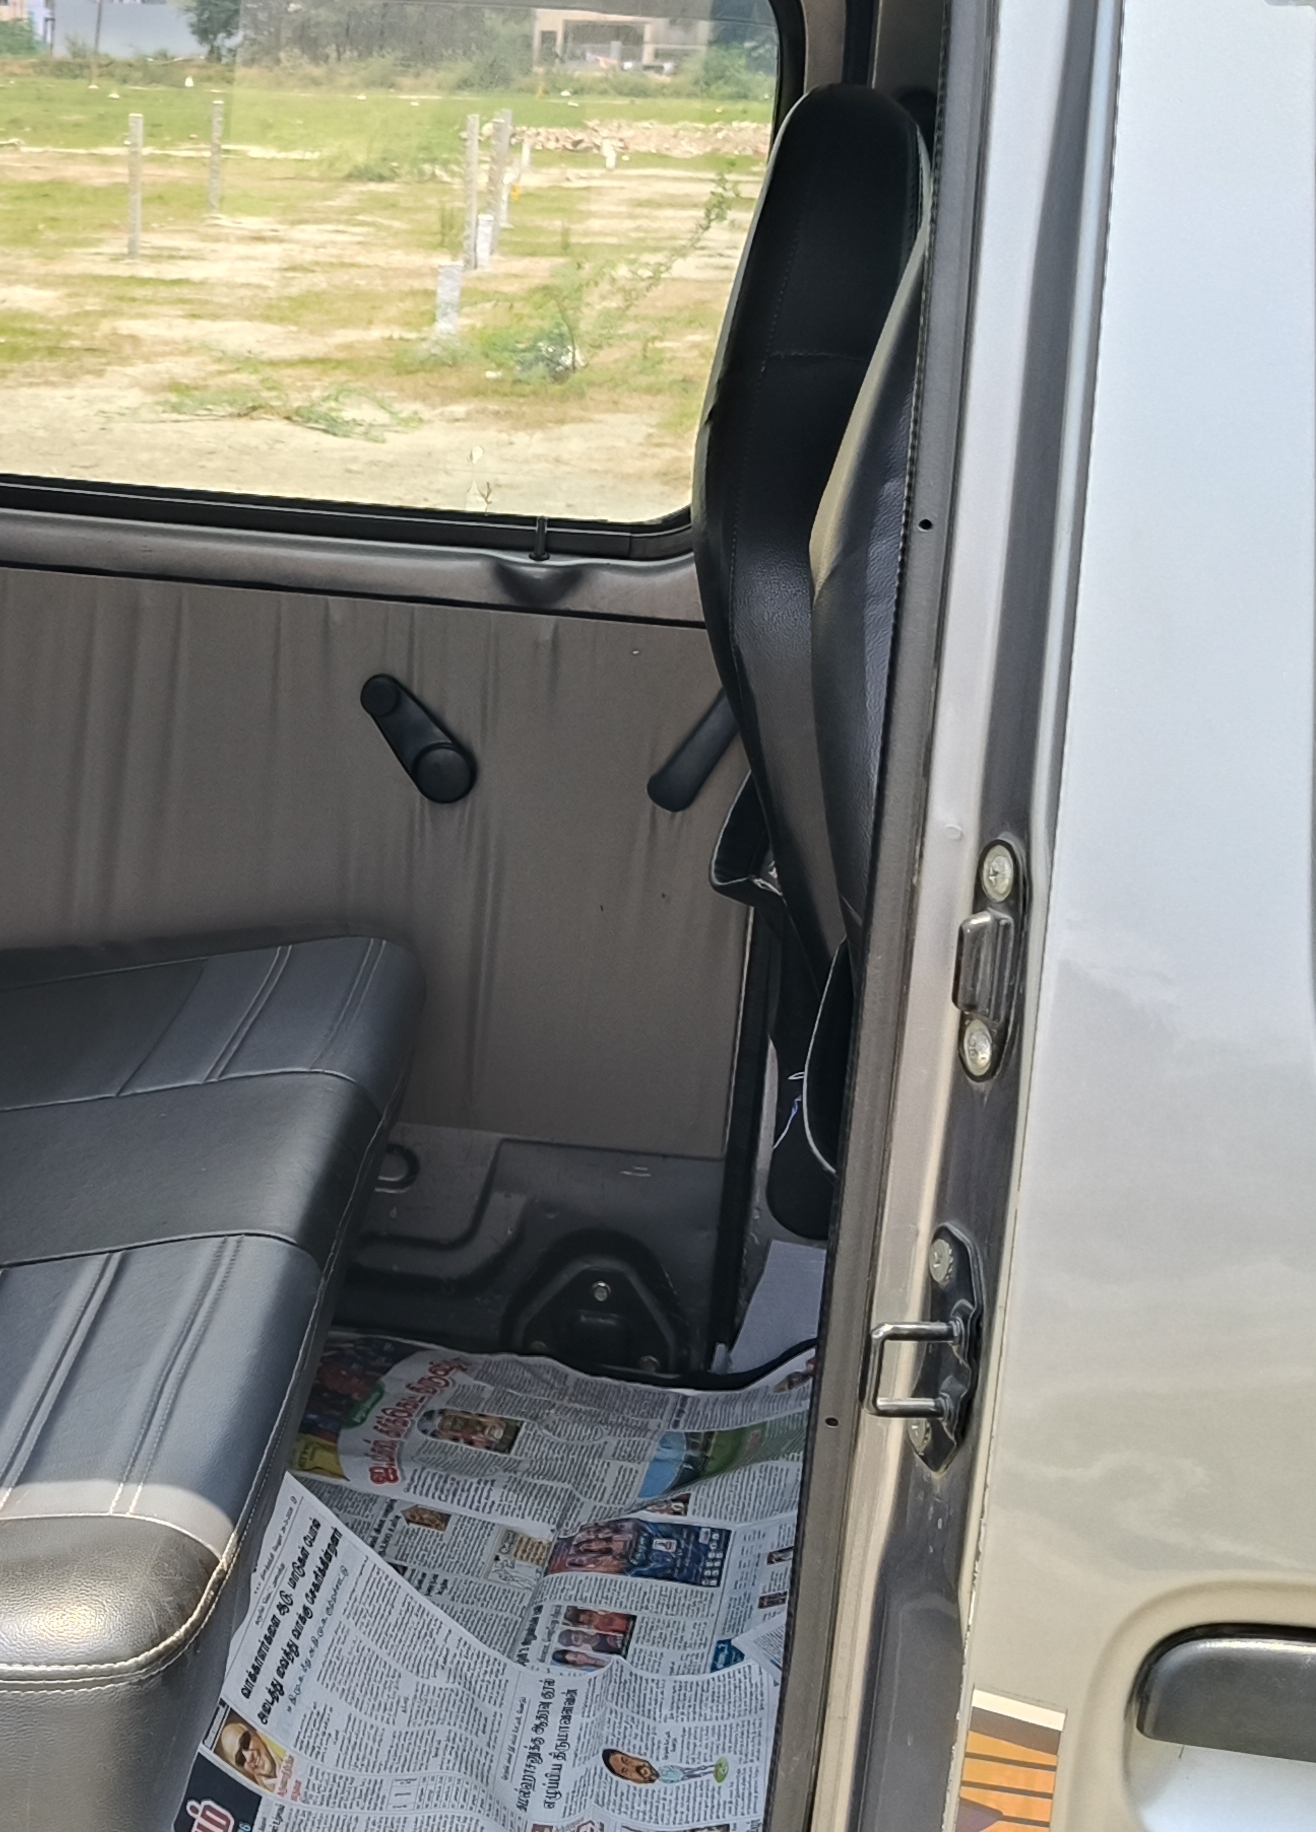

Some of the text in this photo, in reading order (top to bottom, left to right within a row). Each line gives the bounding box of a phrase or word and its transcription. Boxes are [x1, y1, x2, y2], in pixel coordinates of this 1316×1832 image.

[241, 1615, 281, 1699] வாக்காளர்களை
[288, 1546, 309, 1589] மாடுகள்
[303, 1518, 321, 1547] போல்
[326, 1565, 349, 1616] குற்றச்சாட்டு
[257, 1528, 342, 1725] அடைத்து வைத்து வாக்கு சேகரிக்கின்றனர்
[531, 1701, 553, 1734] ஆதரவு
[539, 1679, 555, 1699] குரல்
[549, 1689, 578, 1761] திருமாவளவன்
[514, 1737, 545, 1812] கமல்ஹாசனுக்கு
[542, 1764, 562, 1809] எழுப்பிய
